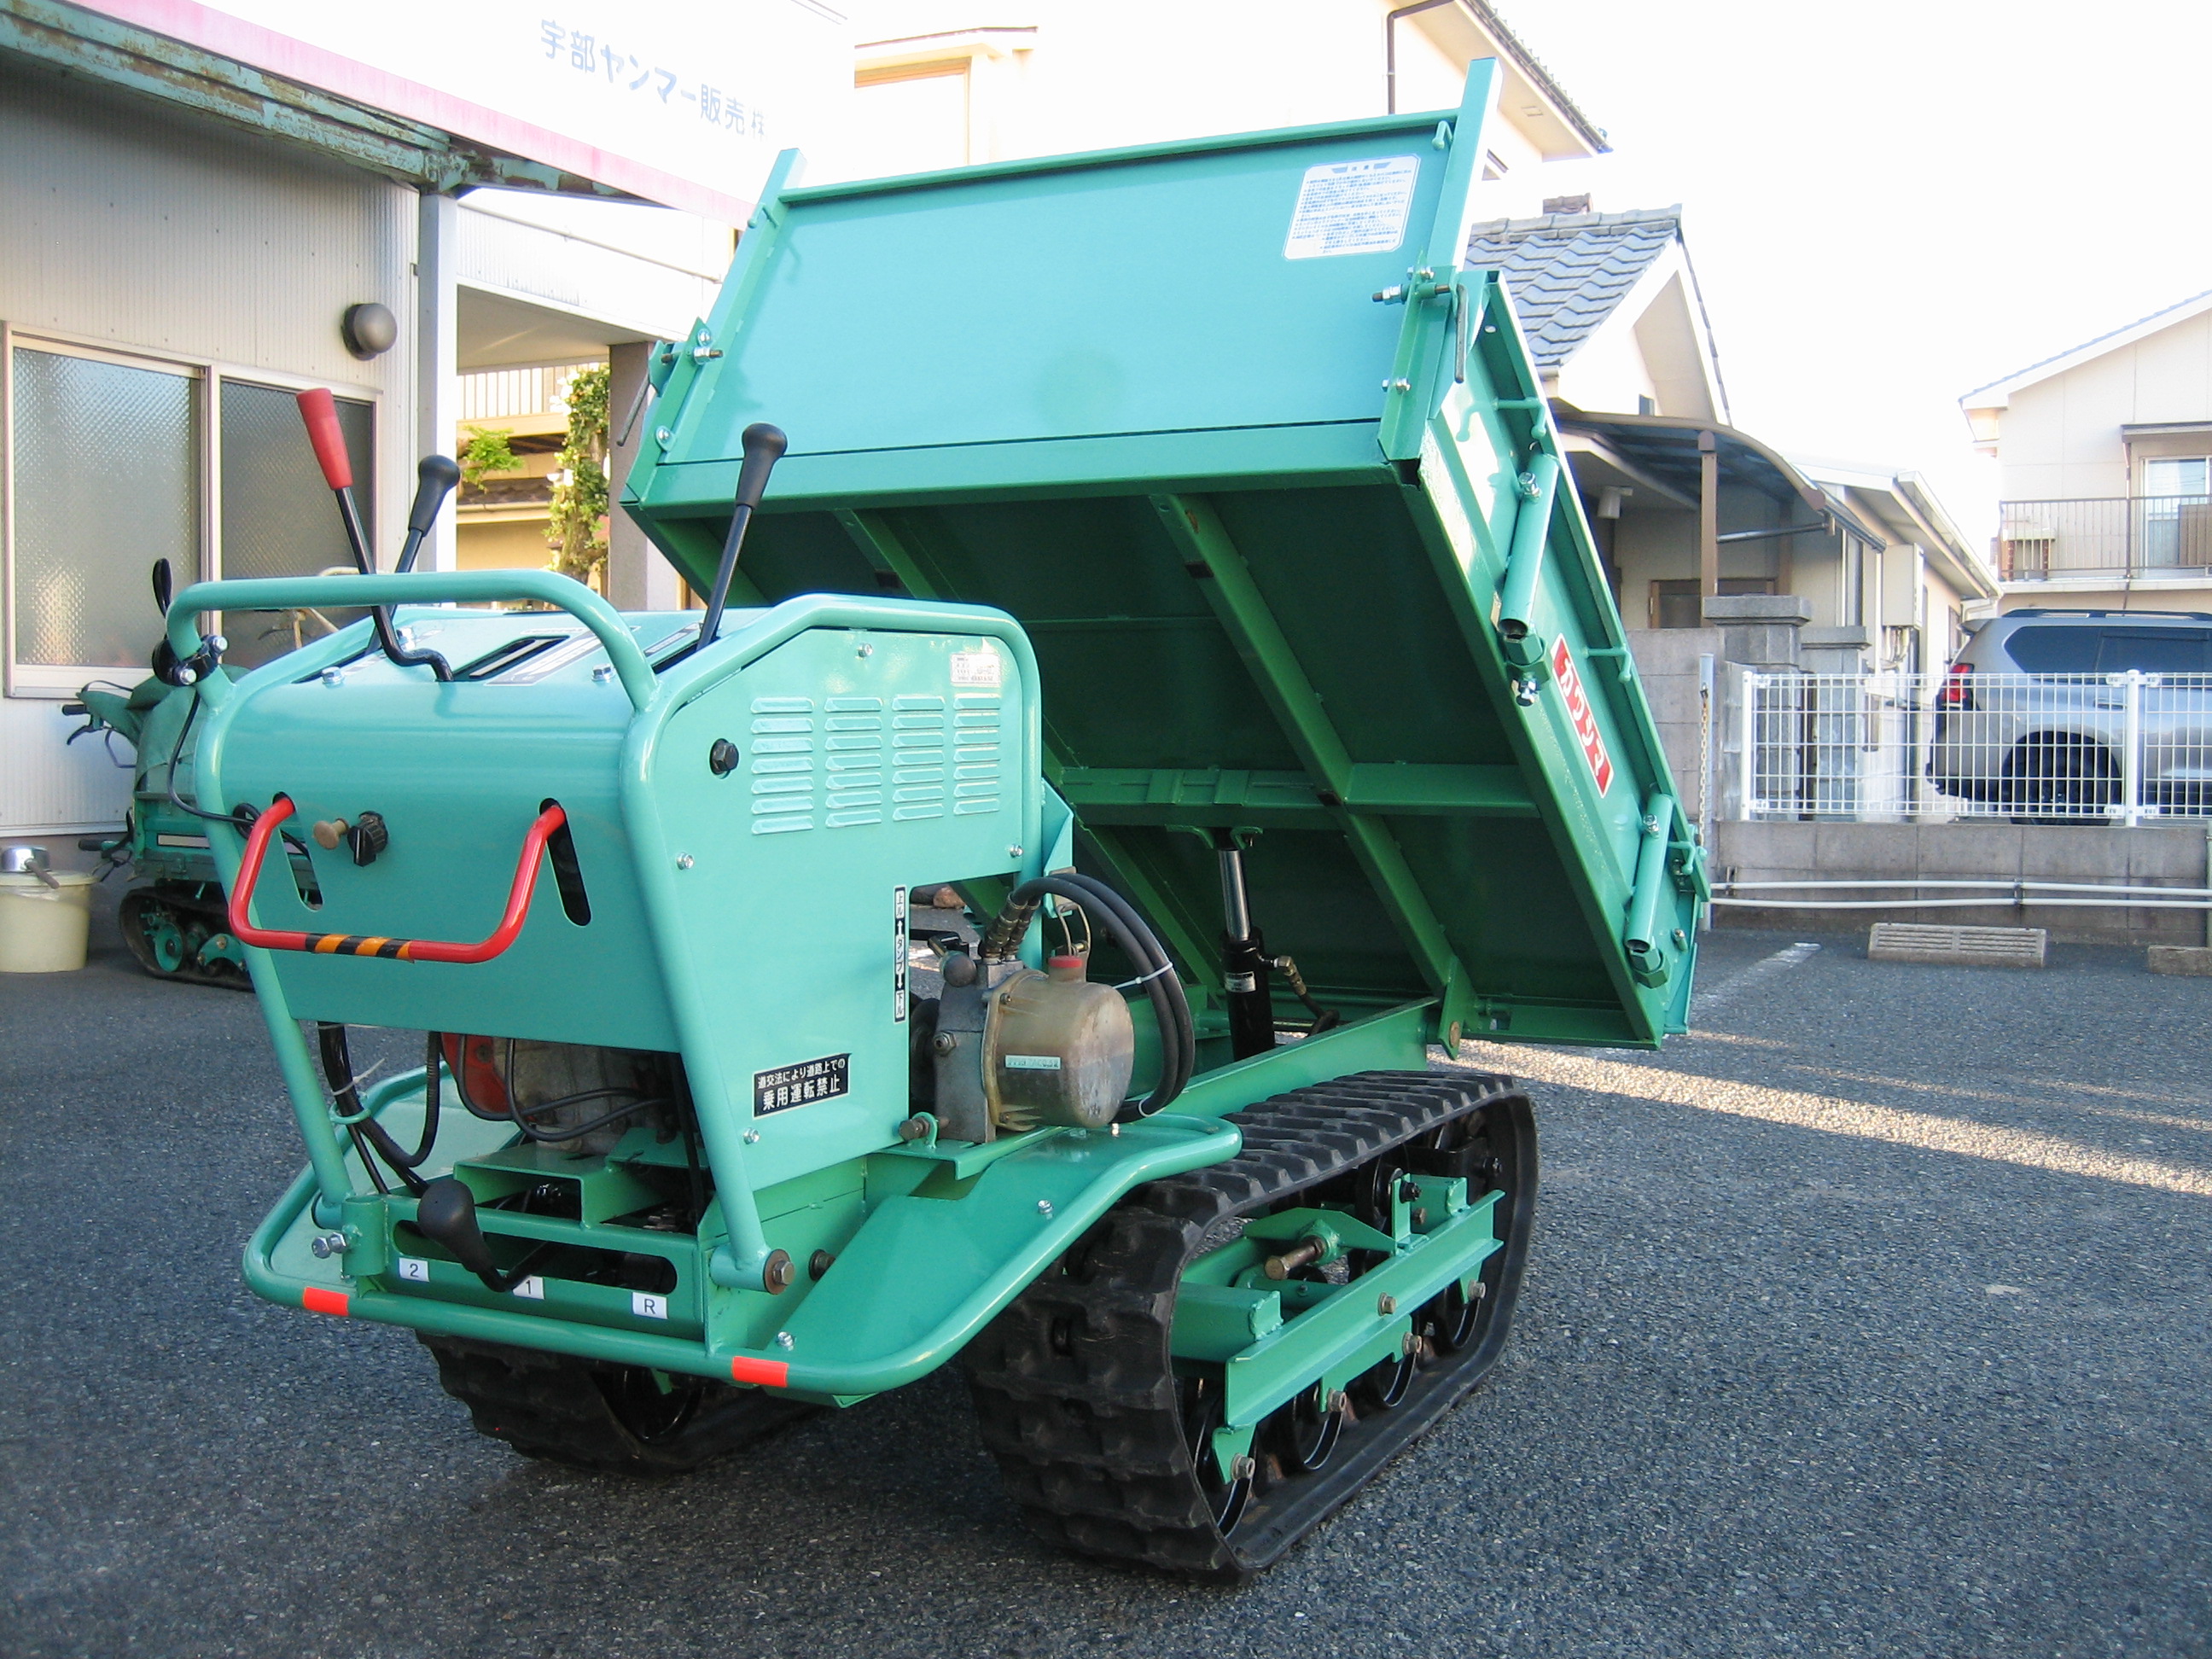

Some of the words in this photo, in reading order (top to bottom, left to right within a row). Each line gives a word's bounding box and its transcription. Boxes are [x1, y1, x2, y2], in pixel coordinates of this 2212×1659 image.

[1560, 657, 1606, 776] カワシマ
[762, 1074, 841, 1111] 乗用運転禁止
[410, 1264, 419, 1278] 2
[525, 1280, 533, 1295] 1
[644, 1299, 655, 1314] R
